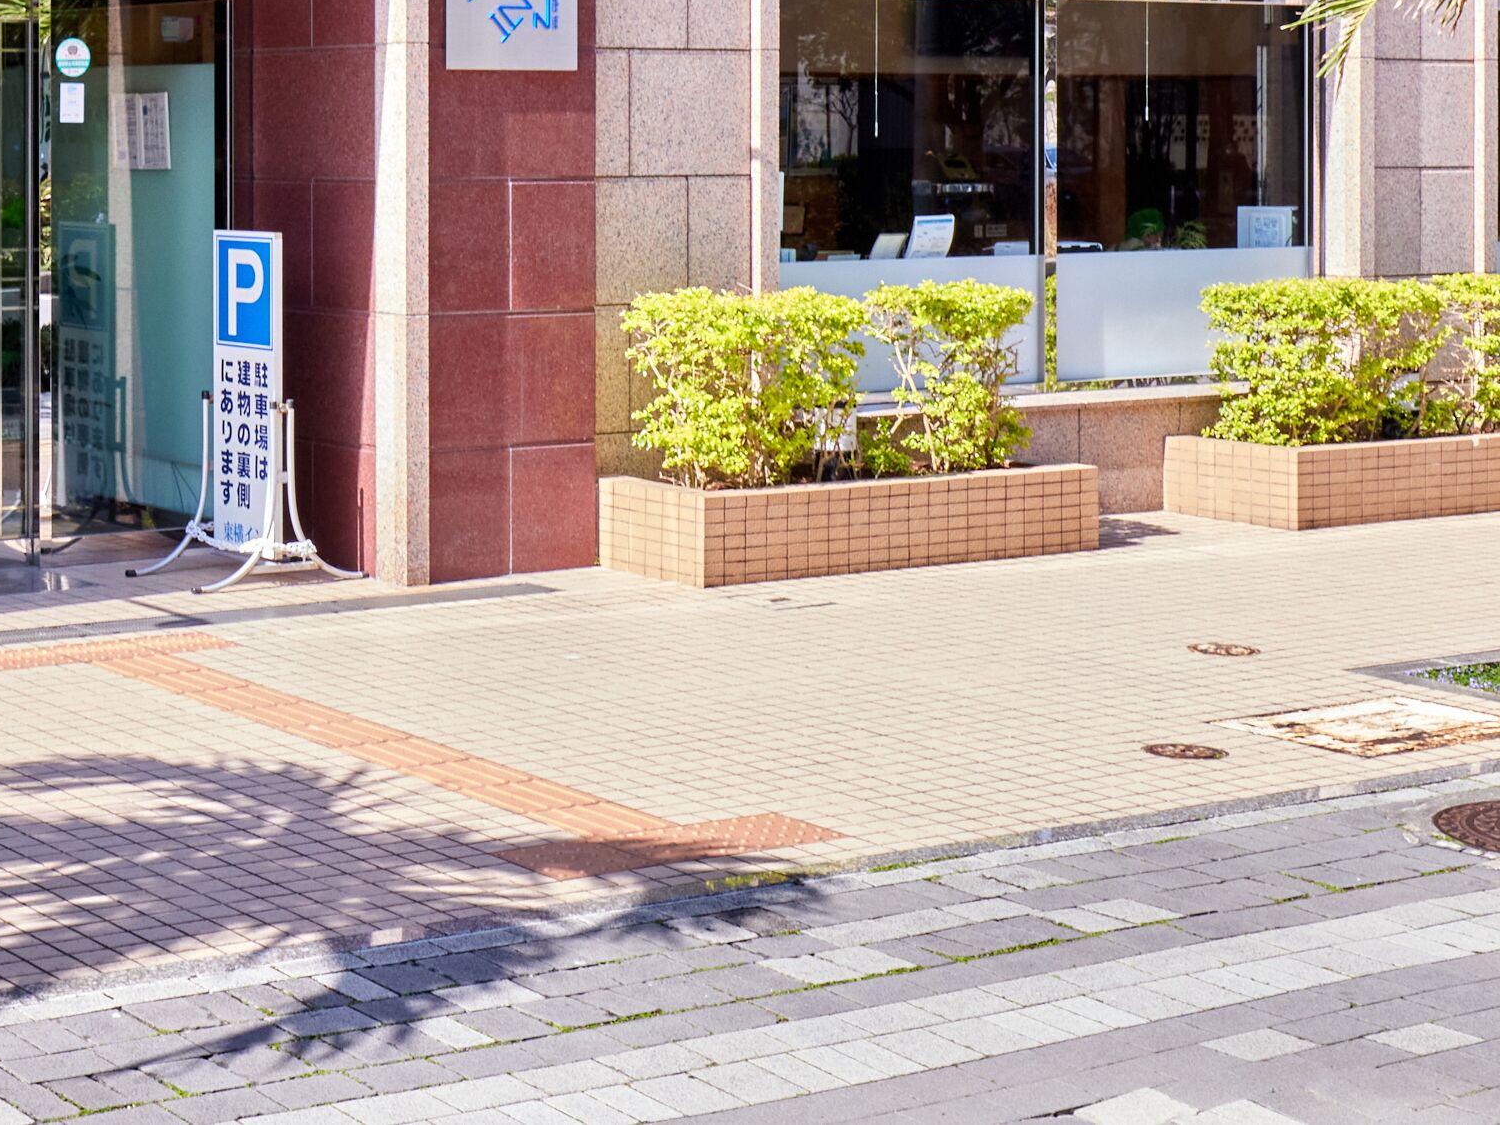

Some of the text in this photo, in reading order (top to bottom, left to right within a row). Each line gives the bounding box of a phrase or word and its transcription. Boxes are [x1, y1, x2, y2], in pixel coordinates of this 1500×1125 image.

[227, 248, 264, 336] P
[220, 359, 234, 505] にあります
[236, 360, 251, 509] 建物の裏側
[254, 362, 268, 480] 駐車場は
[223, 521, 259, 544] 東横イ
